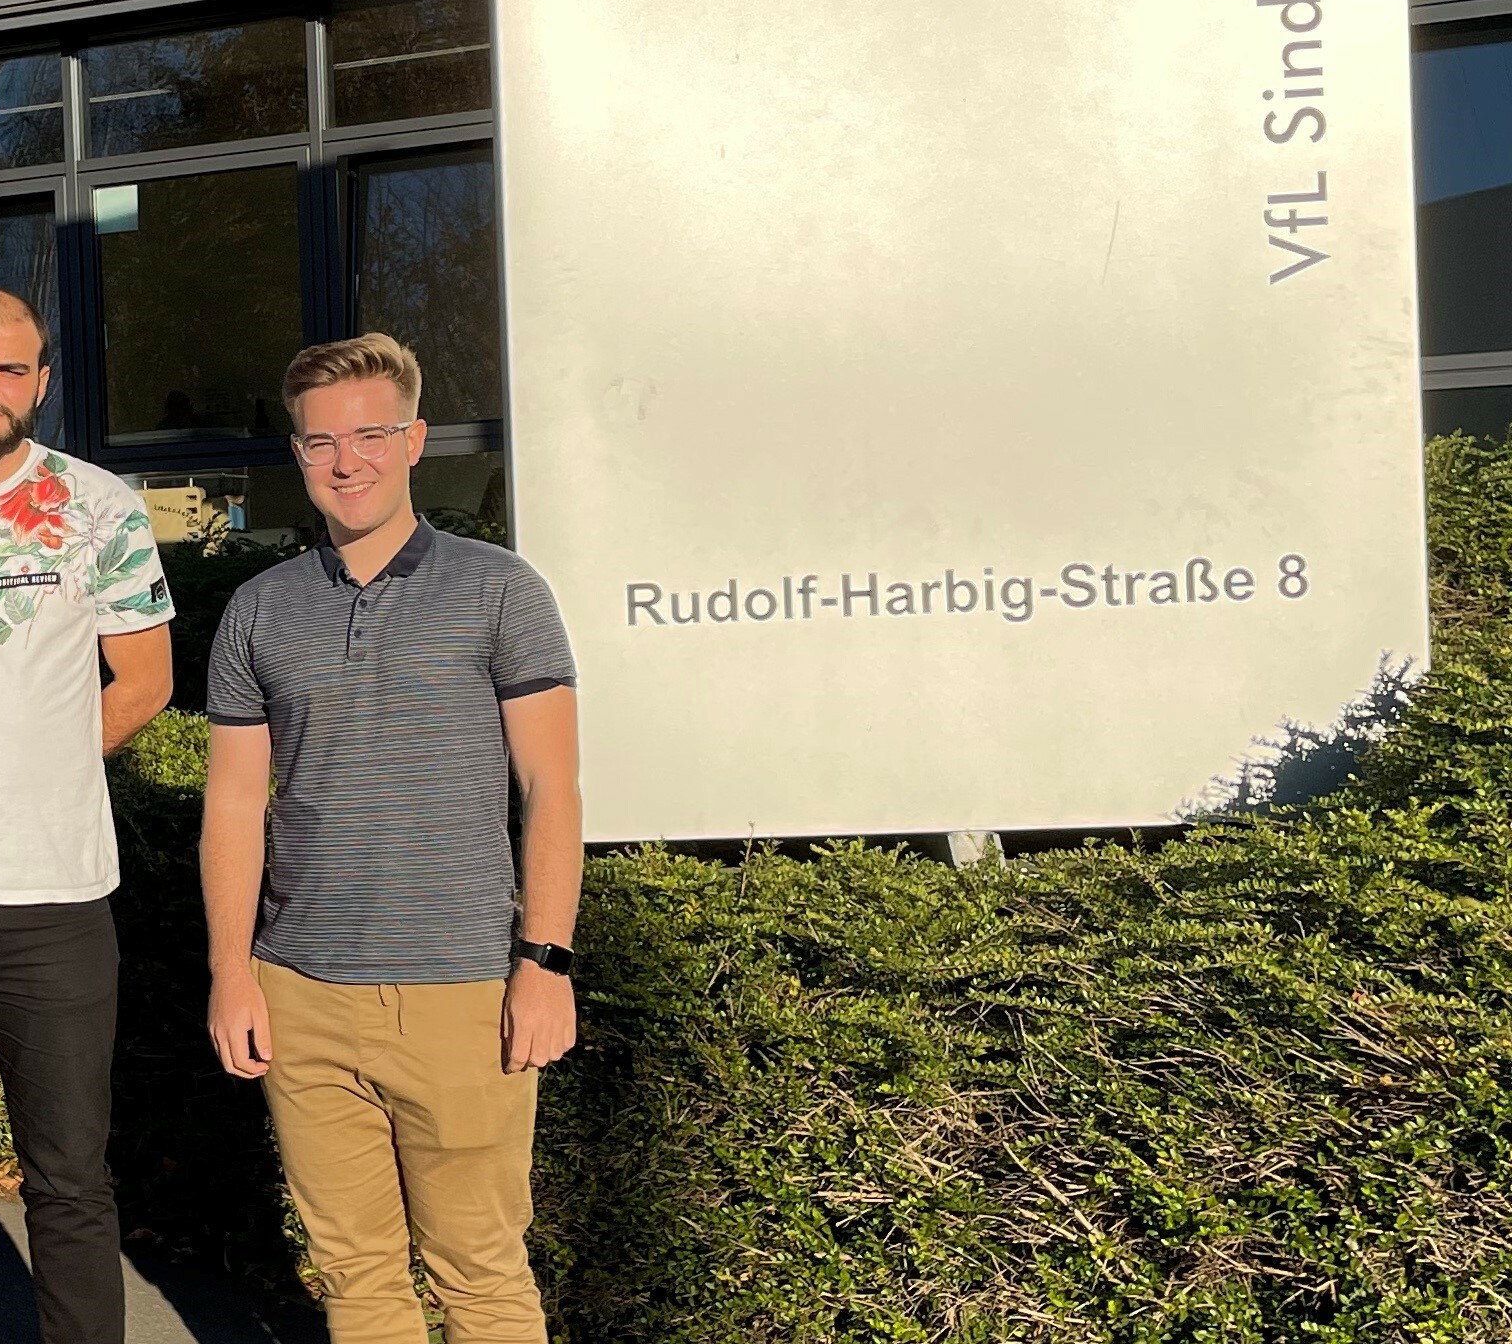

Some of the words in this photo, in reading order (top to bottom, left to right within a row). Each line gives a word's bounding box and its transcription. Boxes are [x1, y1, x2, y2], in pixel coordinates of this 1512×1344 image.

[1263, 170, 1333, 286] VfL
[626, 557, 1255, 627] Rudolf-Harbig-Straße
[1277, 554, 1308, 599] 8
